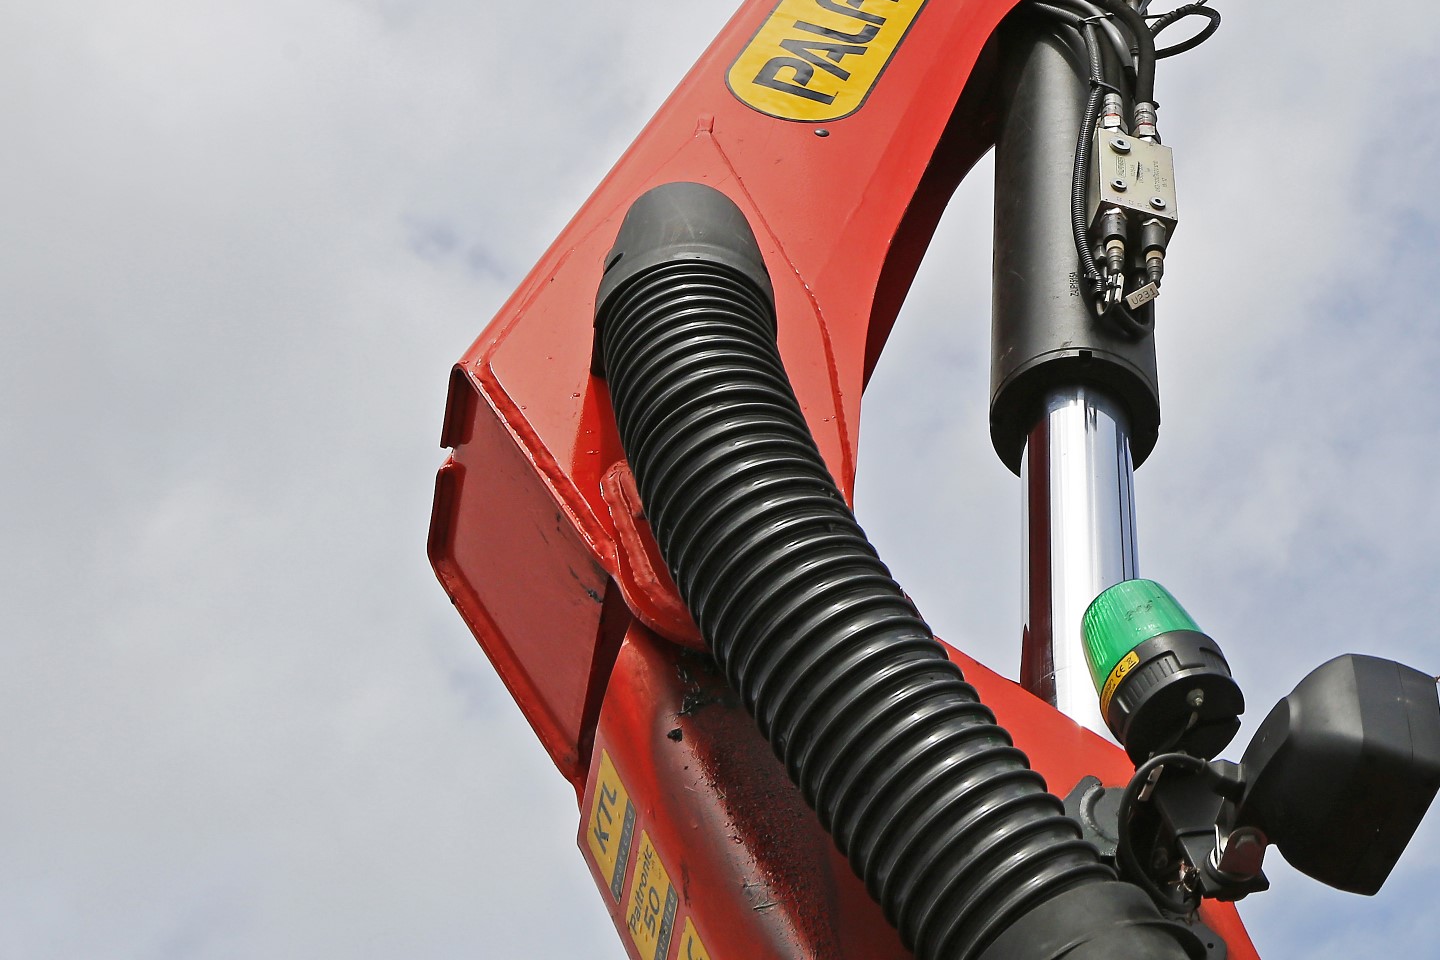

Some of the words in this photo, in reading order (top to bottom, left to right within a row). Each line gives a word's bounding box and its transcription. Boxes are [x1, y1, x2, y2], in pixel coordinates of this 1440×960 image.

[1131, 287, 1156, 305] U231
[594, 781, 617, 854] KTL
[629, 844, 653, 936] Paltronic
[644, 886, 660, 938] 50
